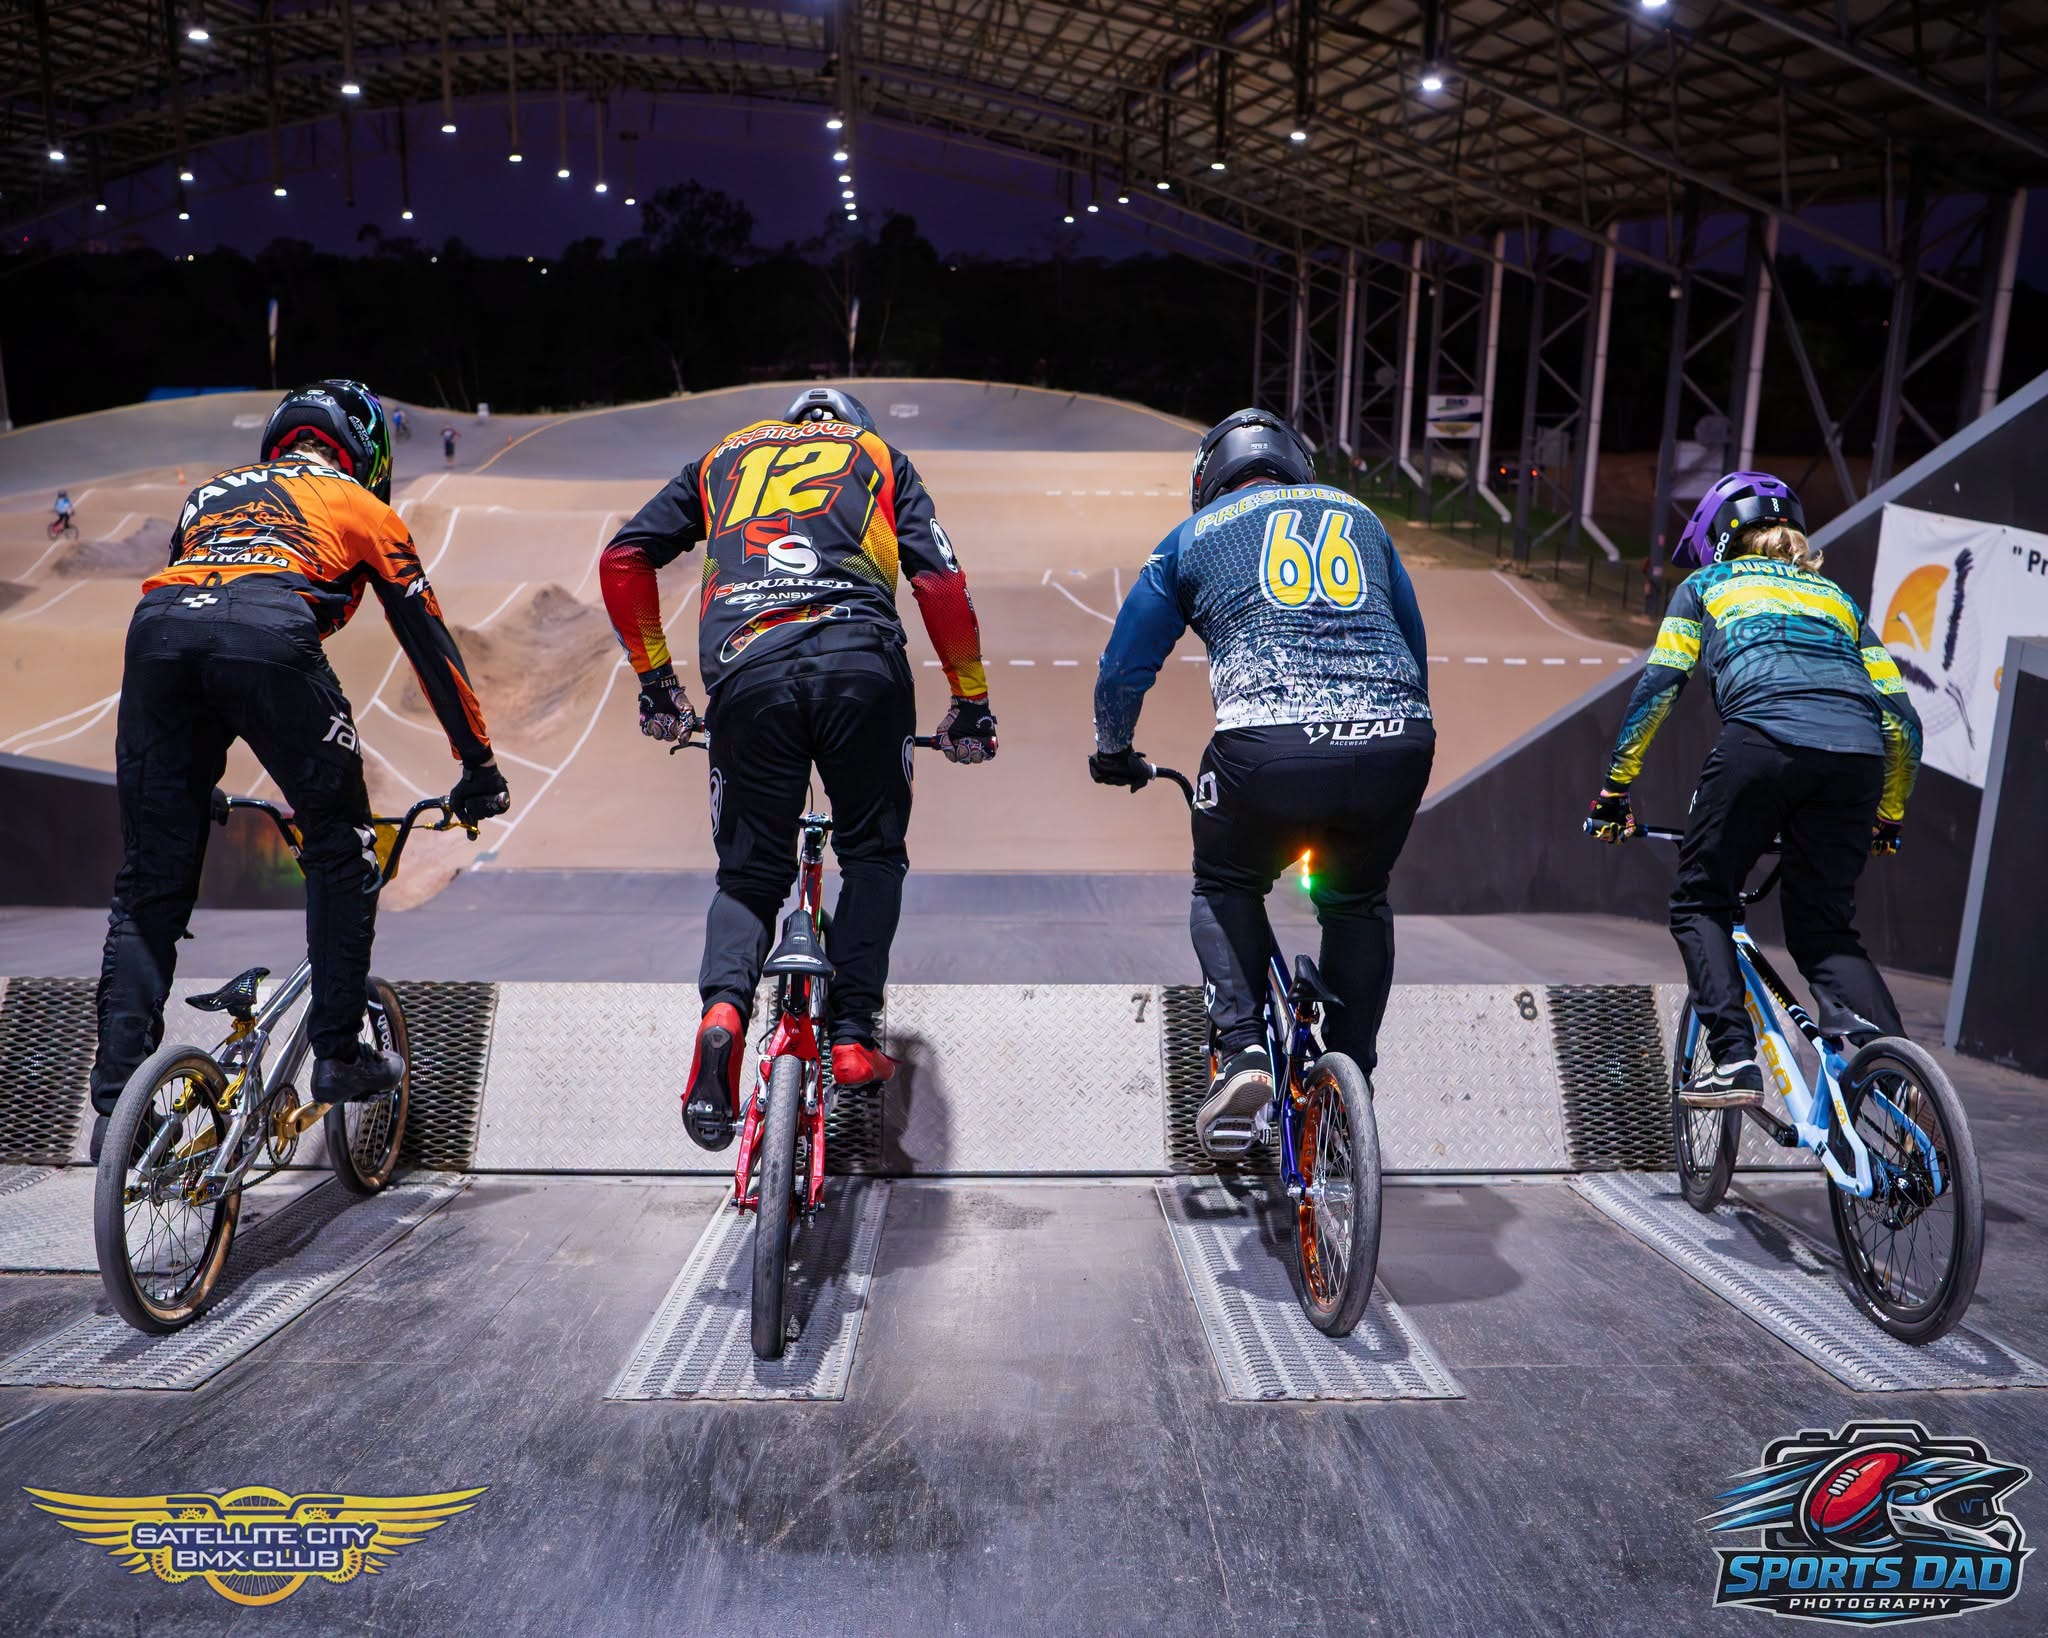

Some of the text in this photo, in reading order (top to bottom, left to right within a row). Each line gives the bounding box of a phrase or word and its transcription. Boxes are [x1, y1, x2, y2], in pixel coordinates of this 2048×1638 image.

[724, 441, 853, 528] 12
[1195, 488, 1372, 537] PRESIDEN
[1259, 509, 1368, 612] 66
[1331, 718, 1405, 741] LEAD
[1131, 991, 1152, 1023] 7
[1519, 989, 1538, 1020] 8
